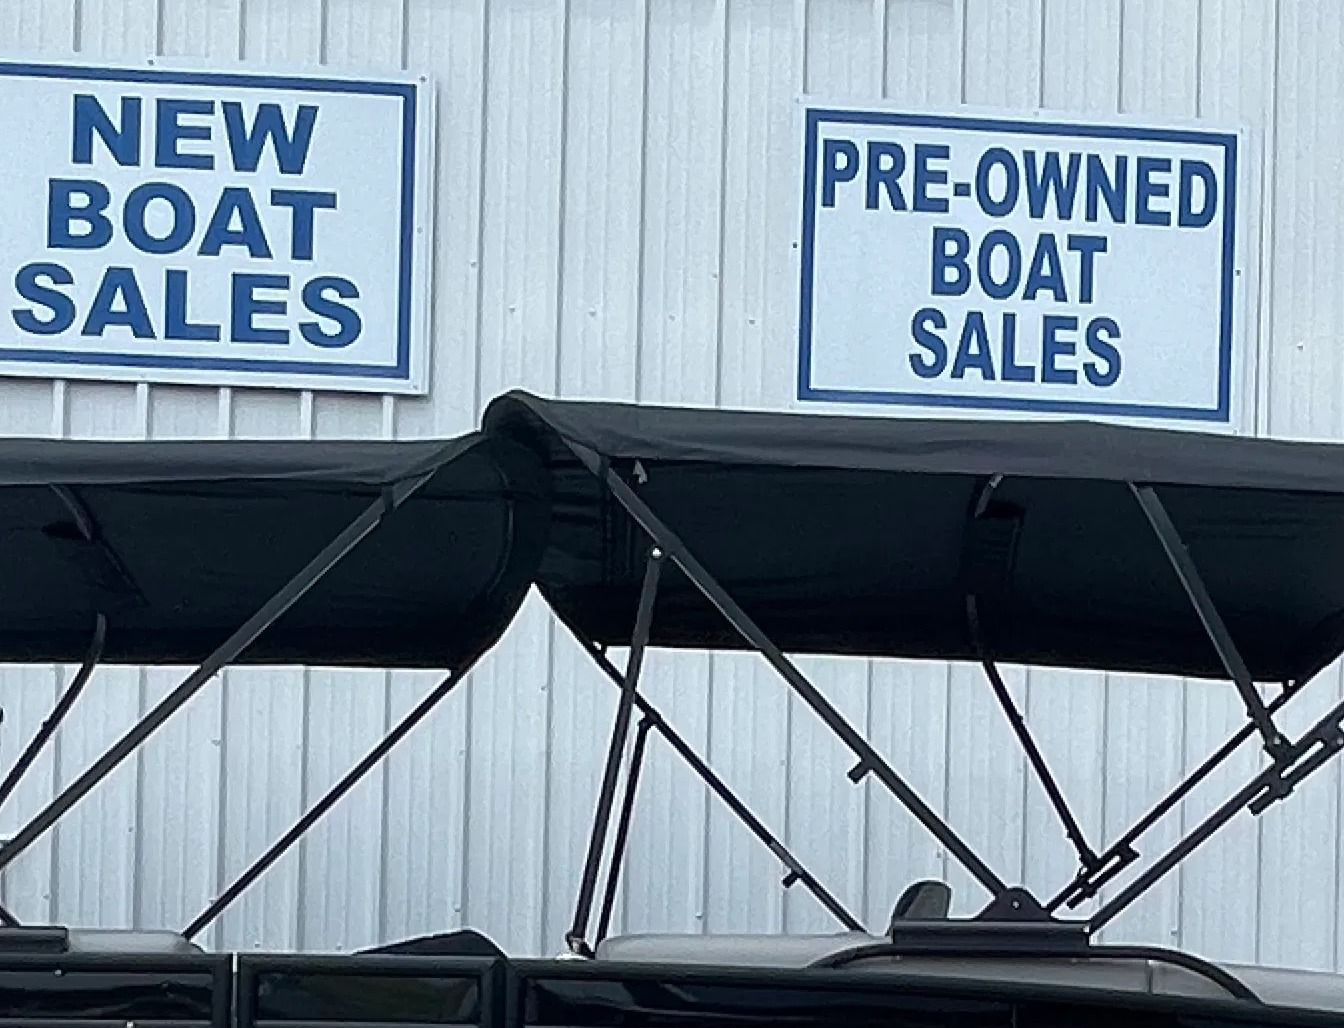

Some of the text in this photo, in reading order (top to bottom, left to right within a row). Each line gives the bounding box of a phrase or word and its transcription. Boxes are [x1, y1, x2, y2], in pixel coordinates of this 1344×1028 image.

[72, 94, 319, 175] NEW
[46, 178, 337, 261] BOAT
[821, 138, 1218, 229] PRE-OWNED
[12, 262, 362, 349] SALES
[931, 227, 1108, 304] BOAT
[909, 308, 1122, 387] SALES
